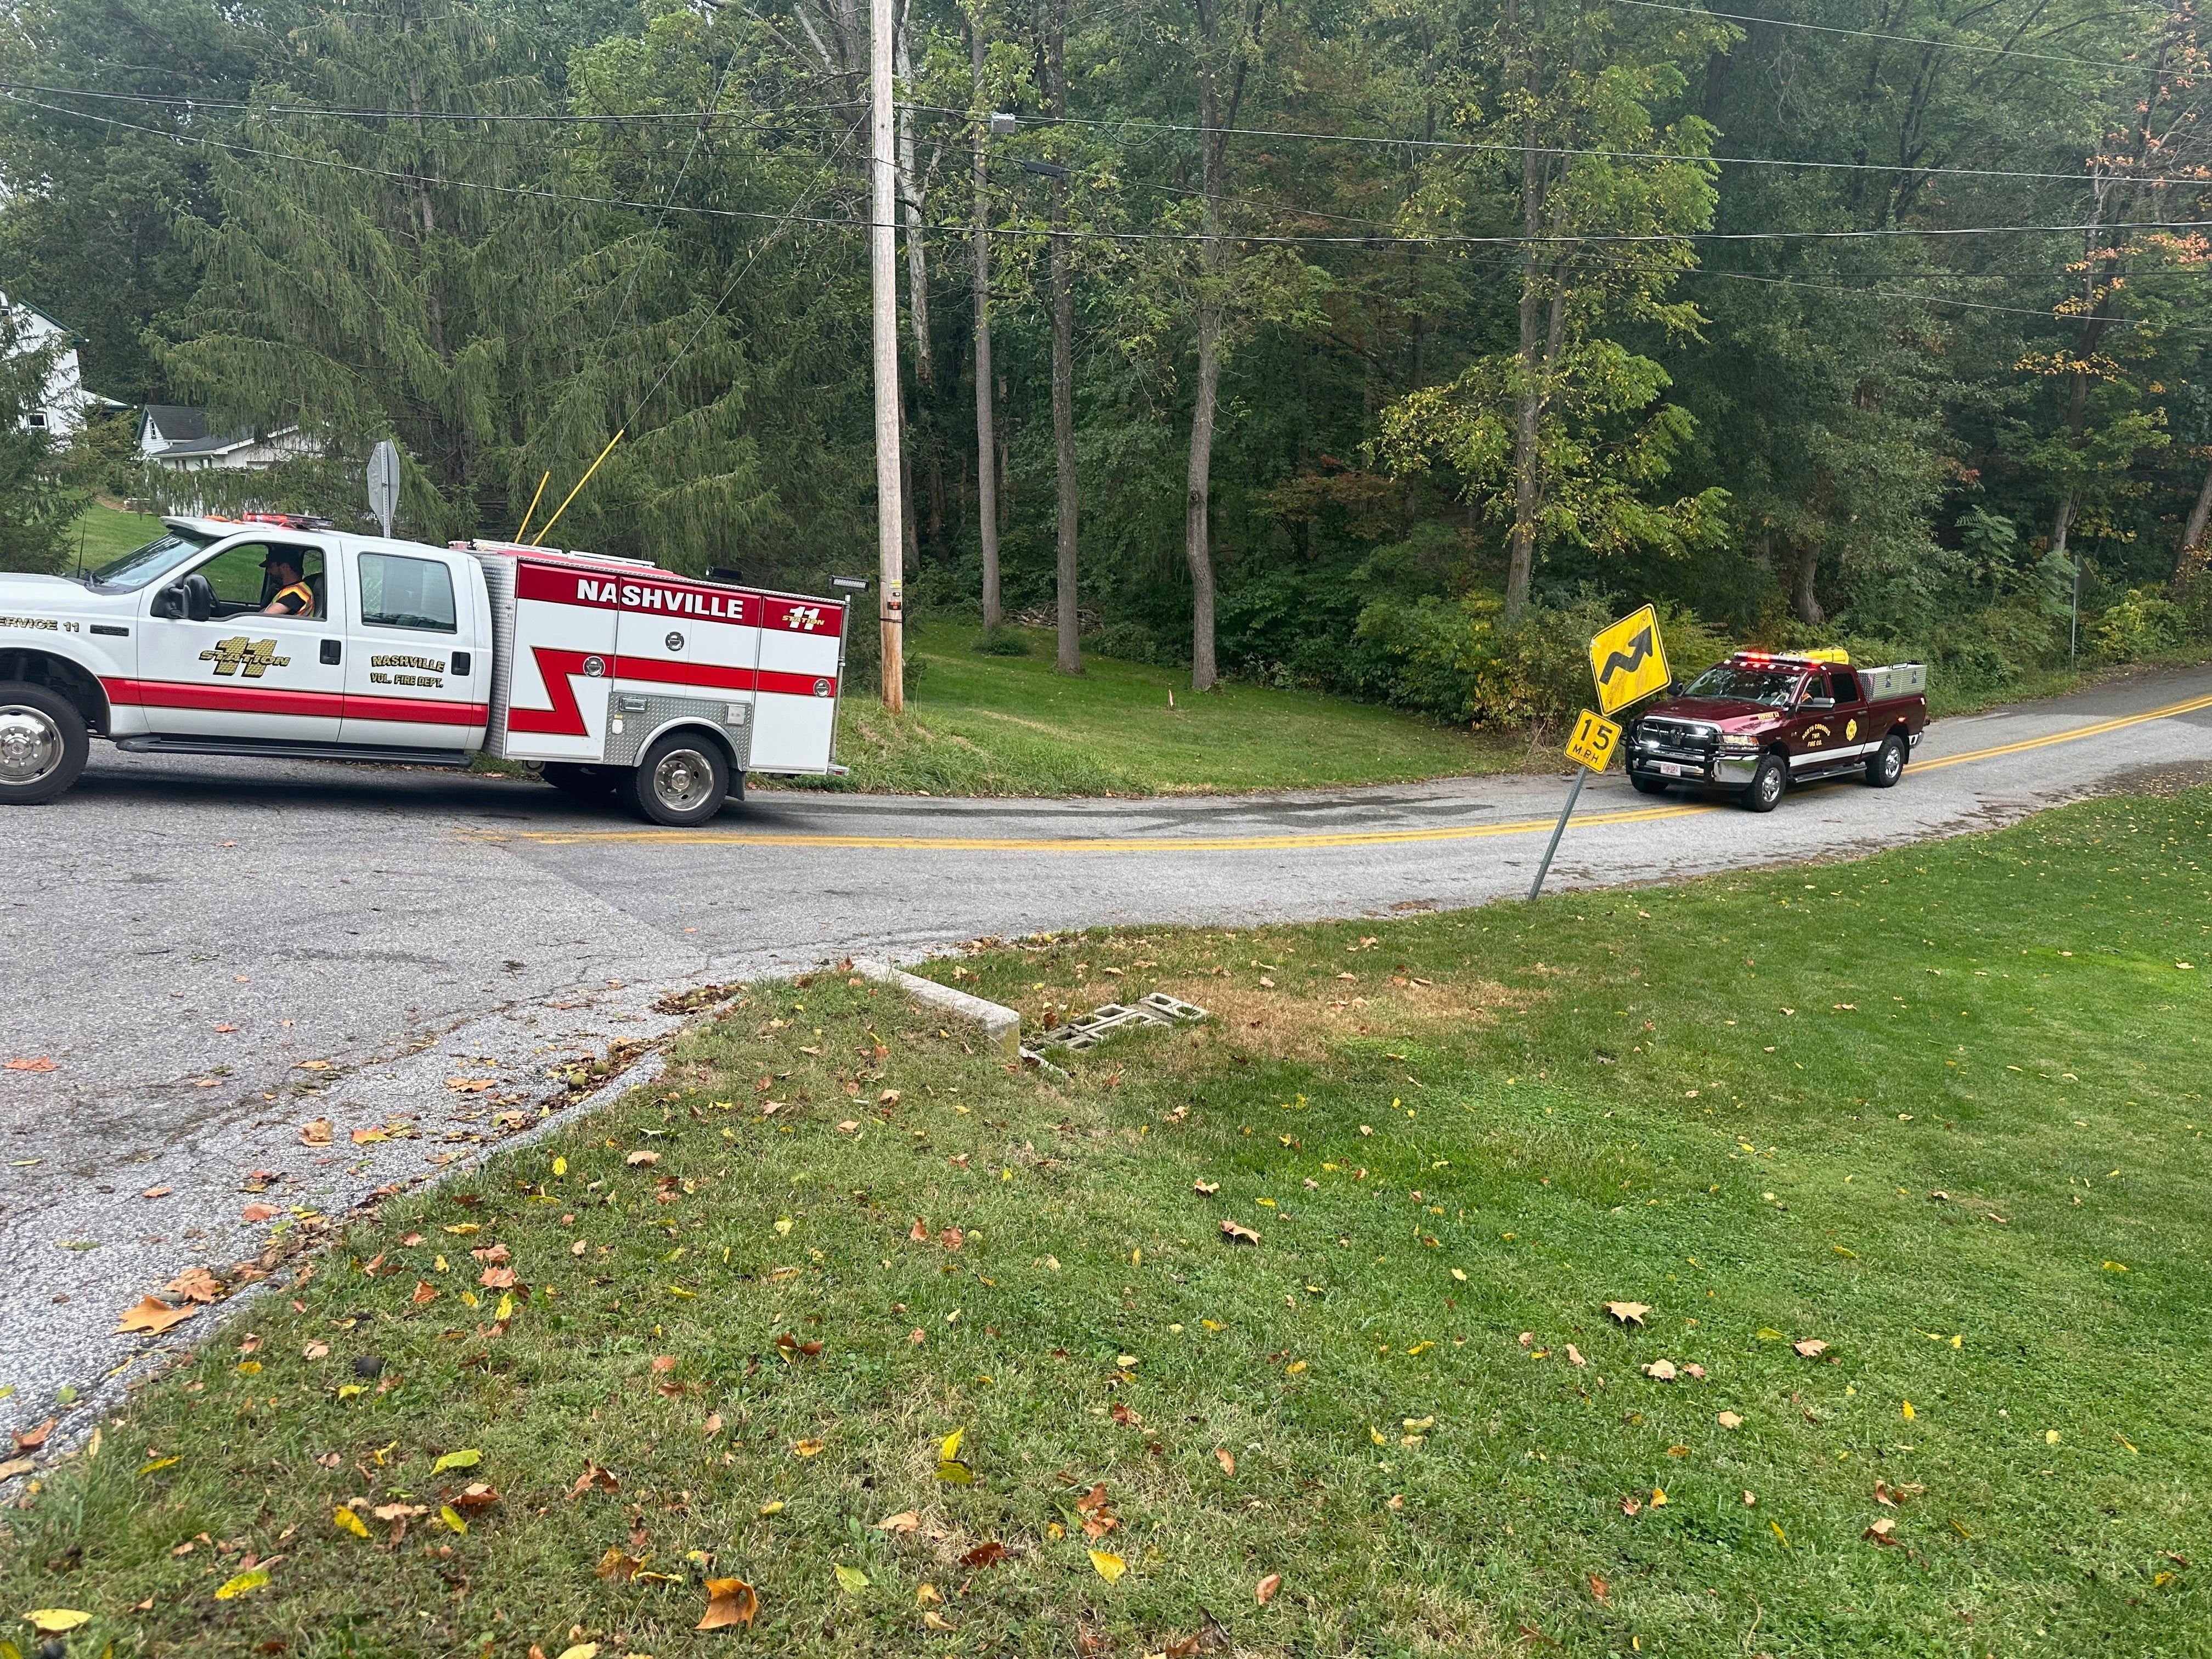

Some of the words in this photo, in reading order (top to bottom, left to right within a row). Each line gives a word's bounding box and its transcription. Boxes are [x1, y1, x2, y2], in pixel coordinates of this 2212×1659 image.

[577, 579, 743, 619] NASHVILLE
[63, 622, 80, 632] 11
[782, 615, 825, 625] STATION
[789, 606, 820, 630] 11
[199, 650, 291, 667] STATION
[213, 636, 278, 678] 11
[371, 655, 445, 673] NASHVILLE
[370, 673, 392, 684] VOL.
[394, 674, 416, 686] FIRE
[417, 676, 444, 688] DEPT.
[1581, 719, 1613, 751] 15
